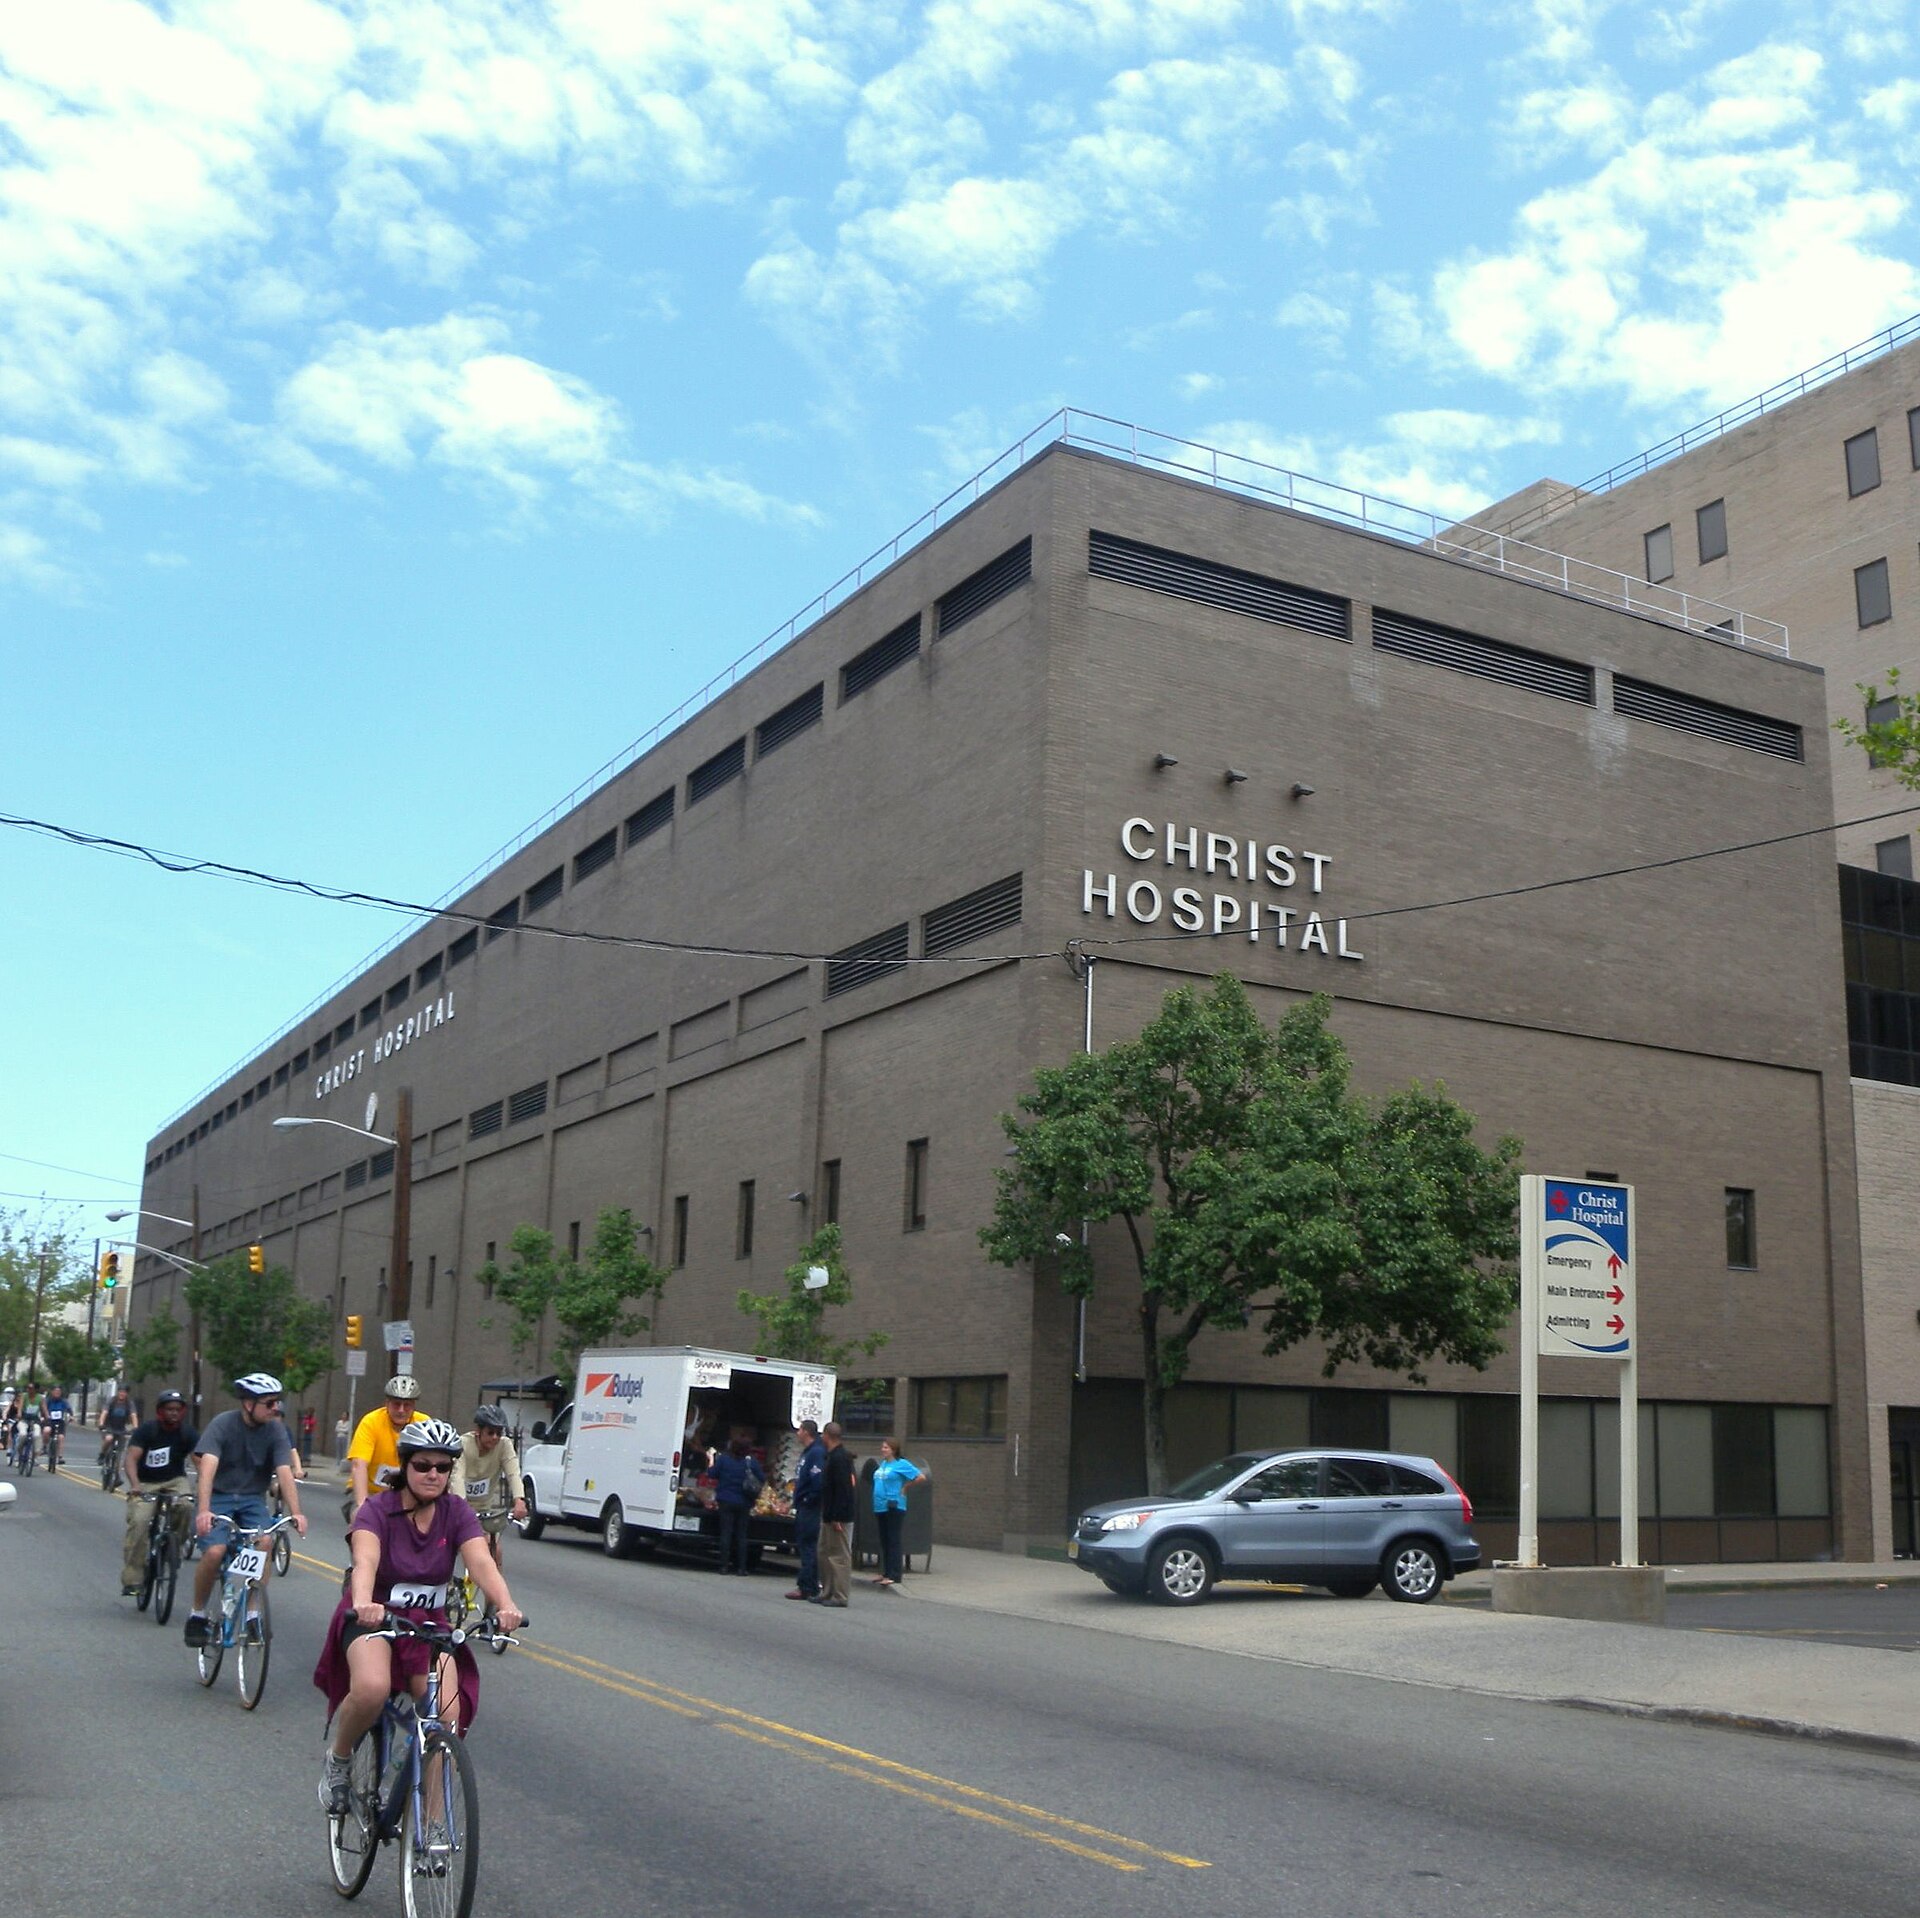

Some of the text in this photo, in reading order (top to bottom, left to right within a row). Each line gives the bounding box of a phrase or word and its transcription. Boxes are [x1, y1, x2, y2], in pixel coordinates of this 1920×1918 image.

[1121, 817, 1333, 894] CHRIST
[1082, 869, 1365, 960] HOSPITAL
[316, 991, 455, 1099] CHRIST HOSPITAL
[1578, 1191, 1617, 1209] Christ
[1572, 1207, 1624, 1227] Hospital
[1547, 1254, 1592, 1270] Emergency
[1547, 1284, 1605, 1300] Main Entrance
[1547, 1314, 1590, 1329] Admitting
[613, 1373, 644, 1404] Budget
[149, 1451, 167, 1465] 199
[466, 1482, 486, 1495] 380
